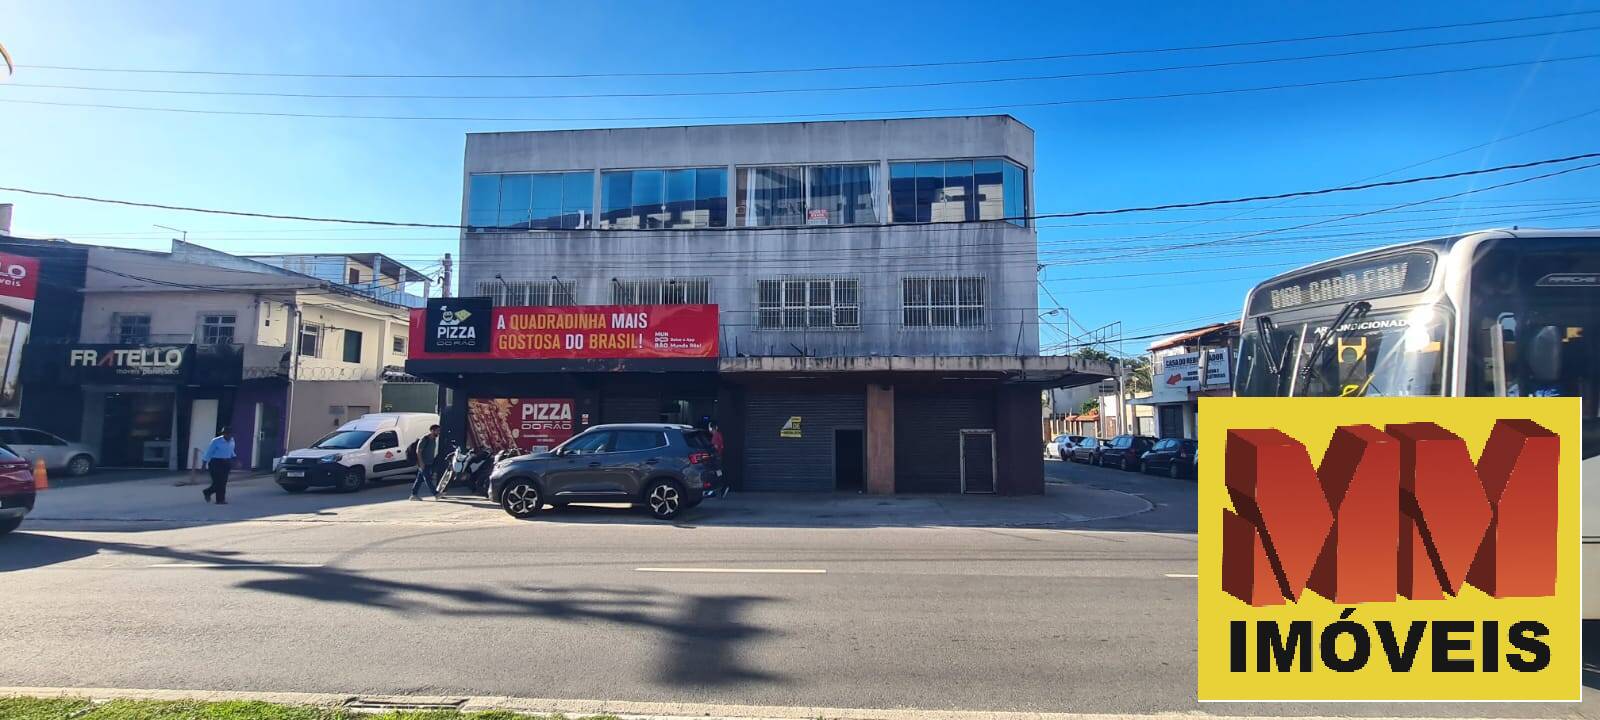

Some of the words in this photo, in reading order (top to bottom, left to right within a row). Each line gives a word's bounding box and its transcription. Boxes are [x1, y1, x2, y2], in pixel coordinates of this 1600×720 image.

[497, 314, 506, 330] A
[510, 313, 606, 330] QUADRADINHA
[611, 313, 648, 329] MAIS
[437, 326, 476, 339] PIZZA
[498, 334, 561, 350] GOSTOSA
[565, 333, 584, 350] DO
[70, 349, 182, 368] FRATELLO
[521, 403, 572, 420] PIZZA
